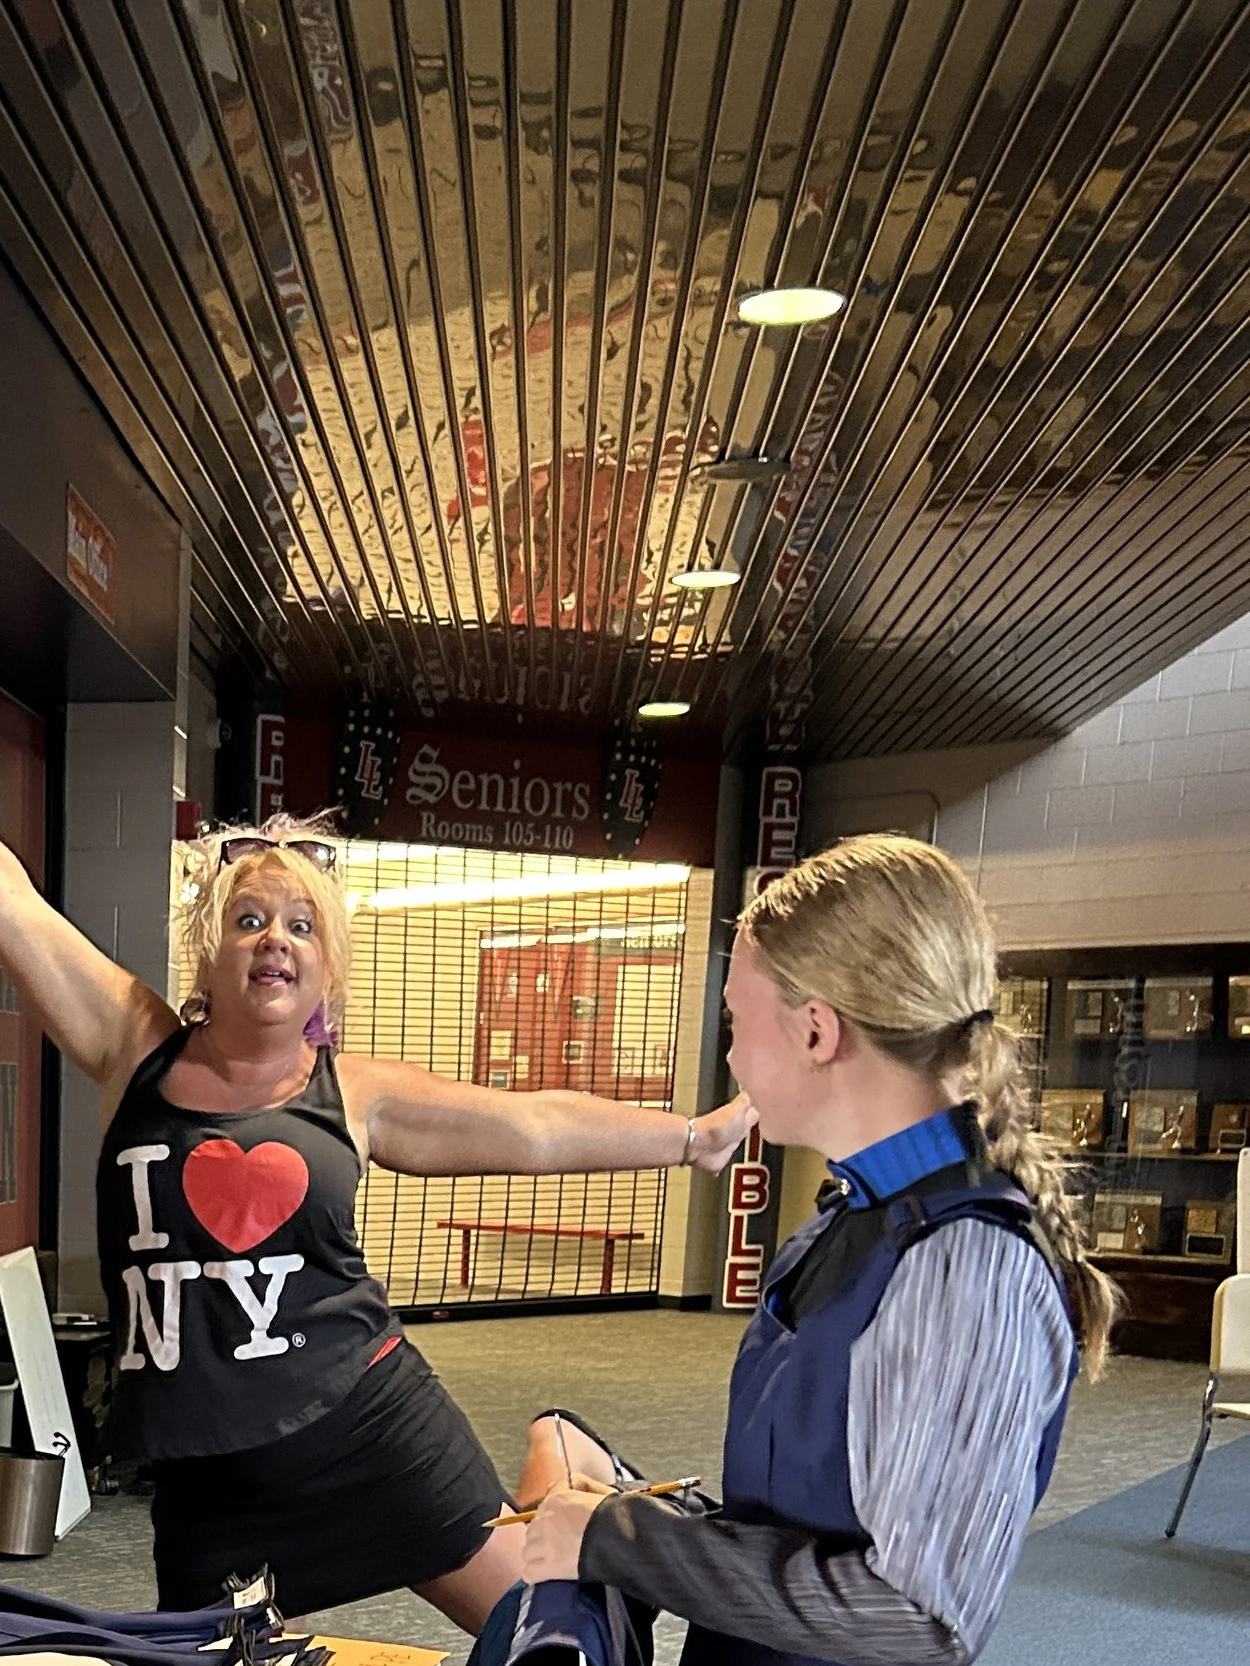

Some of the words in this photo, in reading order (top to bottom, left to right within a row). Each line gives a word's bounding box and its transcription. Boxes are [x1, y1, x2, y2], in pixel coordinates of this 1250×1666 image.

[406, 744, 590, 821] Seniors
[420, 811, 494, 844] Rooms
[503, 821, 574, 850] 105-110
[116, 1144, 170, 1251] I
[120, 1254, 305, 1371] NY
